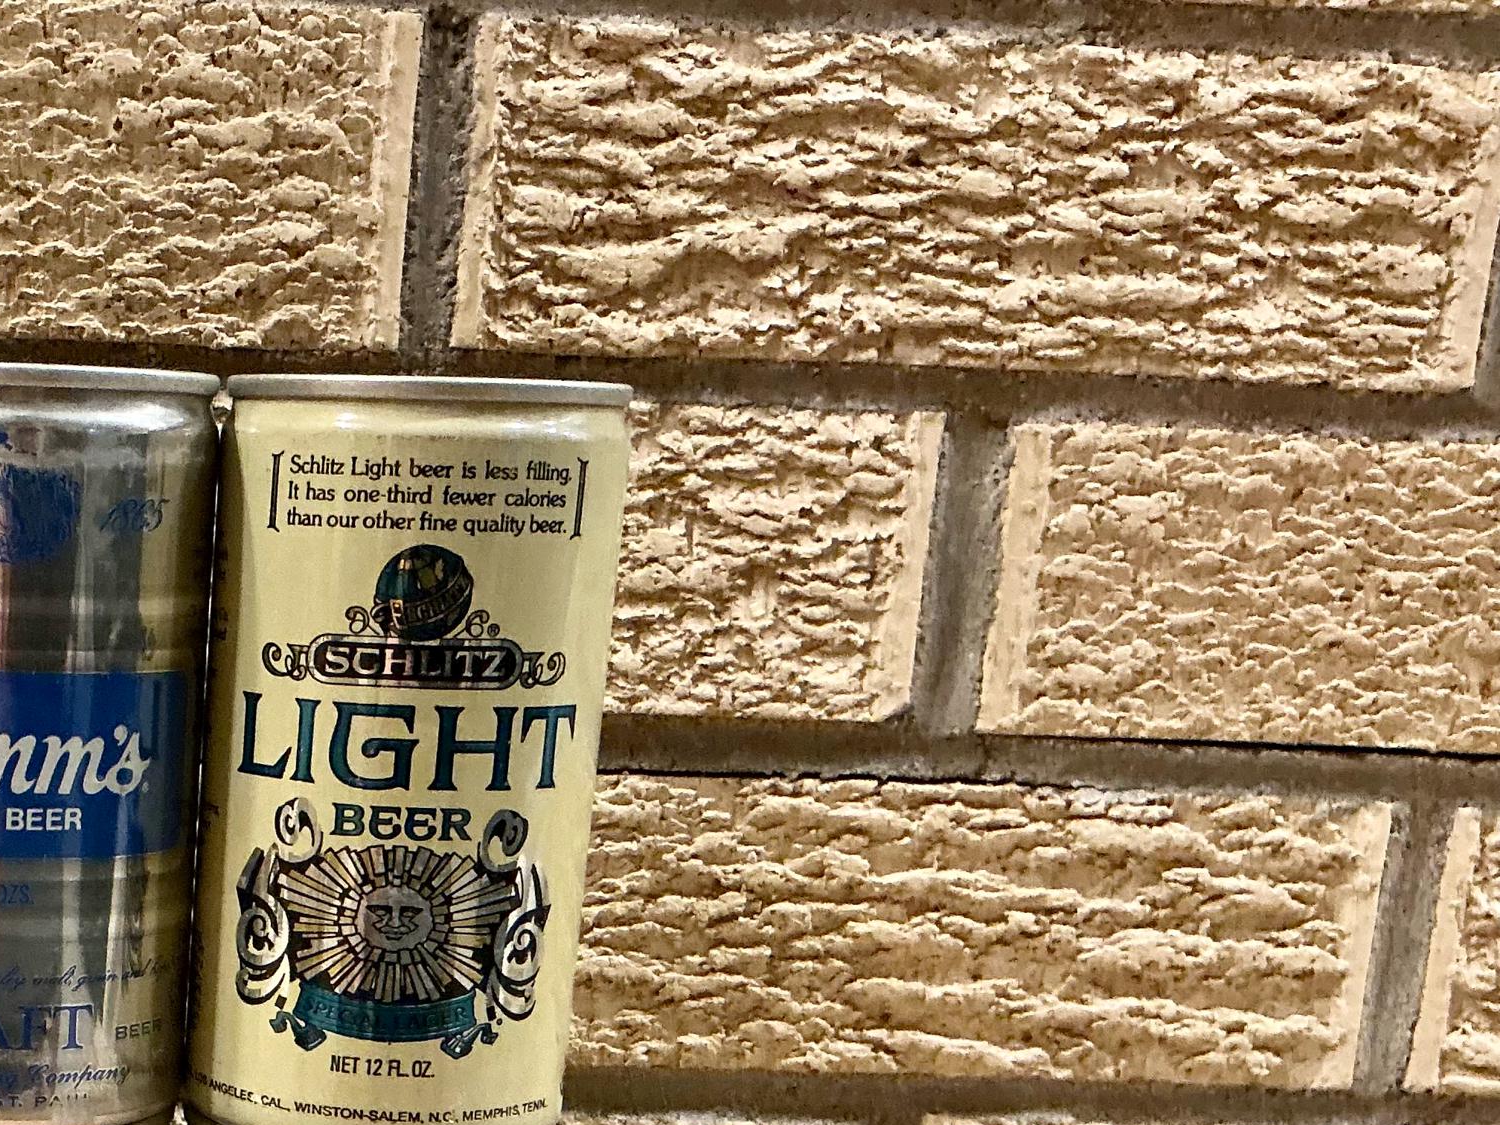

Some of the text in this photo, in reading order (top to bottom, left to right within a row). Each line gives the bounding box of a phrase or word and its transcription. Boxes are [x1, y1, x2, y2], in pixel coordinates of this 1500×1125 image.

[290, 454, 572, 485] Schlitz Light beer is less filling.
[288, 481, 566, 509] It has one-third fewer calories
[286, 509, 567, 538] than our other fine quality beer.
[325, 646, 507, 678] SCHLITZ
[237, 690, 576, 791] LIGHT
[6, 807, 83, 831] BEER
[329, 803, 473, 842] BEER
[116, 1018, 163, 1041] BEER
[28, 1062, 132, 1089] Company
[330, 1055, 360, 1074] NET
[365, 1059, 382, 1076] 12
[412, 1060, 435, 1078] OZ.
